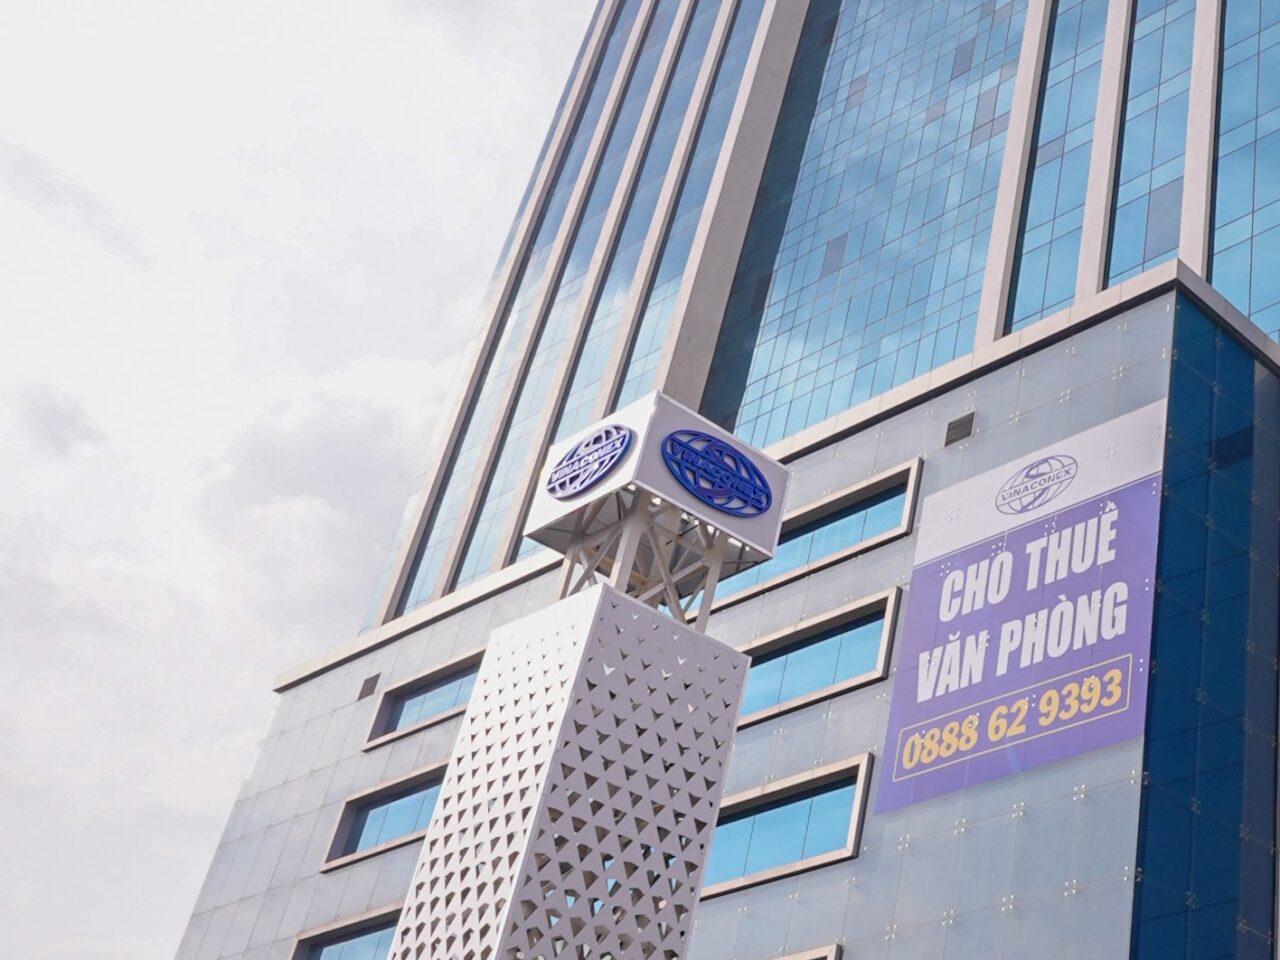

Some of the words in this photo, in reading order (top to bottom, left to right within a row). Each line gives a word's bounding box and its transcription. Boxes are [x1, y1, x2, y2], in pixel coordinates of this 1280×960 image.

[551, 437, 624, 482] VINACONEX
[670, 440, 764, 500] VINACONEX
[1001, 467, 1072, 501] VINACONEX
[939, 550, 1014, 622] CHO
[1026, 500, 1119, 591] THUÊ
[916, 630, 989, 704] VĂN
[996, 581, 1129, 677] PHÒNG
[902, 714, 979, 770] 0888
[987, 699, 1029, 742] 62
[1038, 668, 1123, 727] 9393
